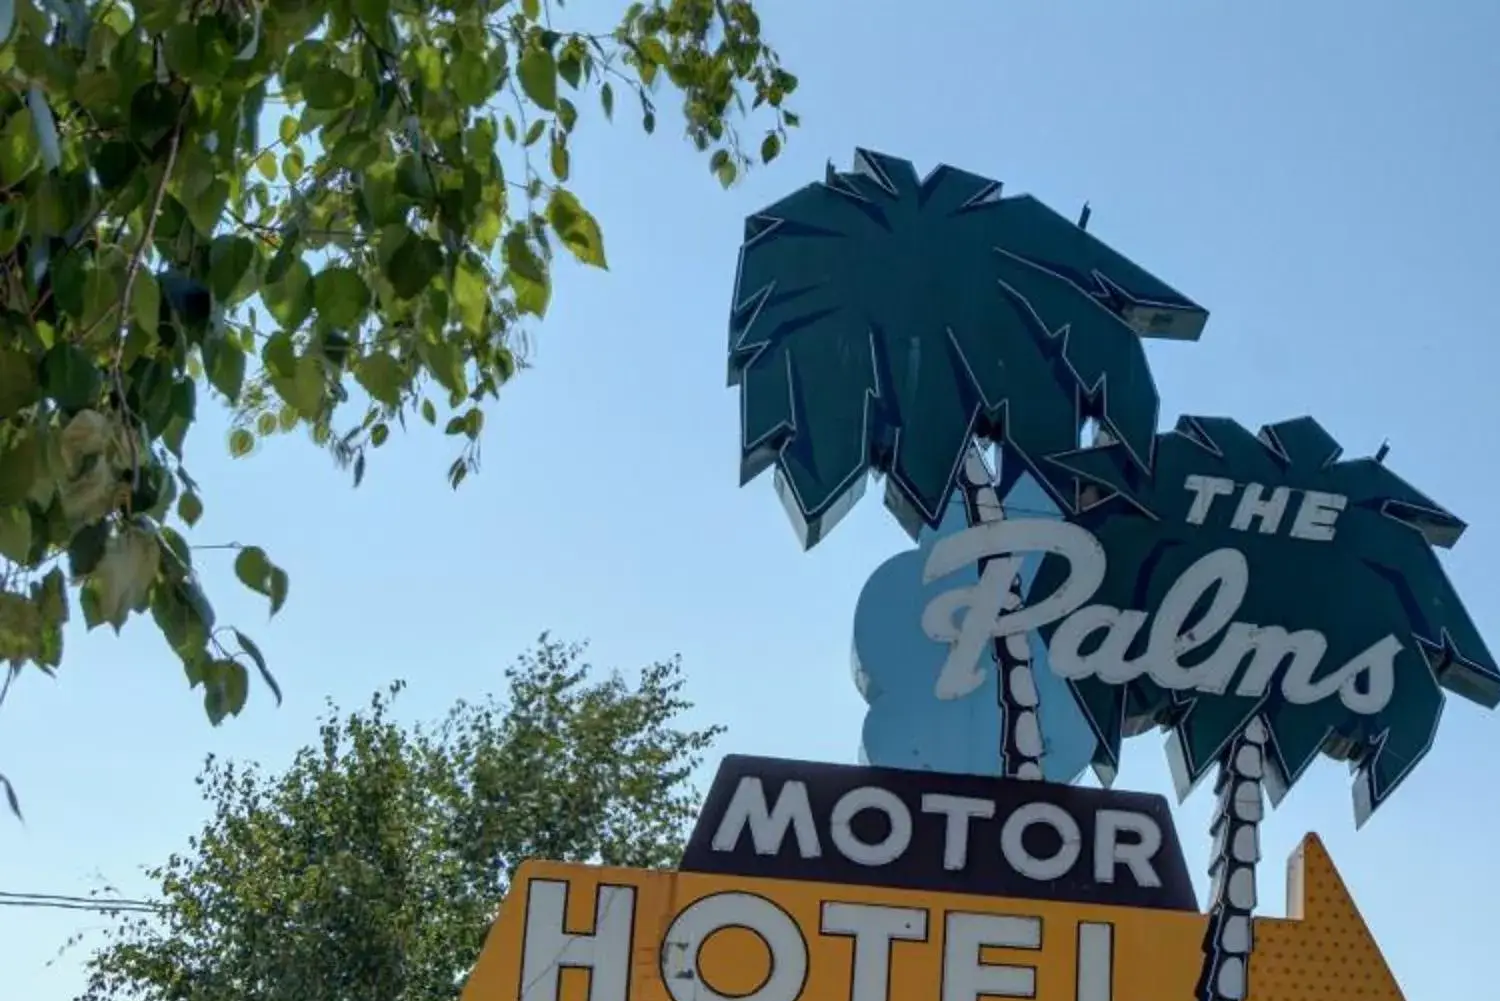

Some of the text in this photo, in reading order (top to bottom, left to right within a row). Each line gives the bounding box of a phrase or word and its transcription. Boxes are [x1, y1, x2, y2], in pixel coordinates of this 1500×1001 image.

[1184, 474, 1348, 542] THE
[921, 518, 1404, 715] Palms
[711, 776, 1163, 888] MOTOR
